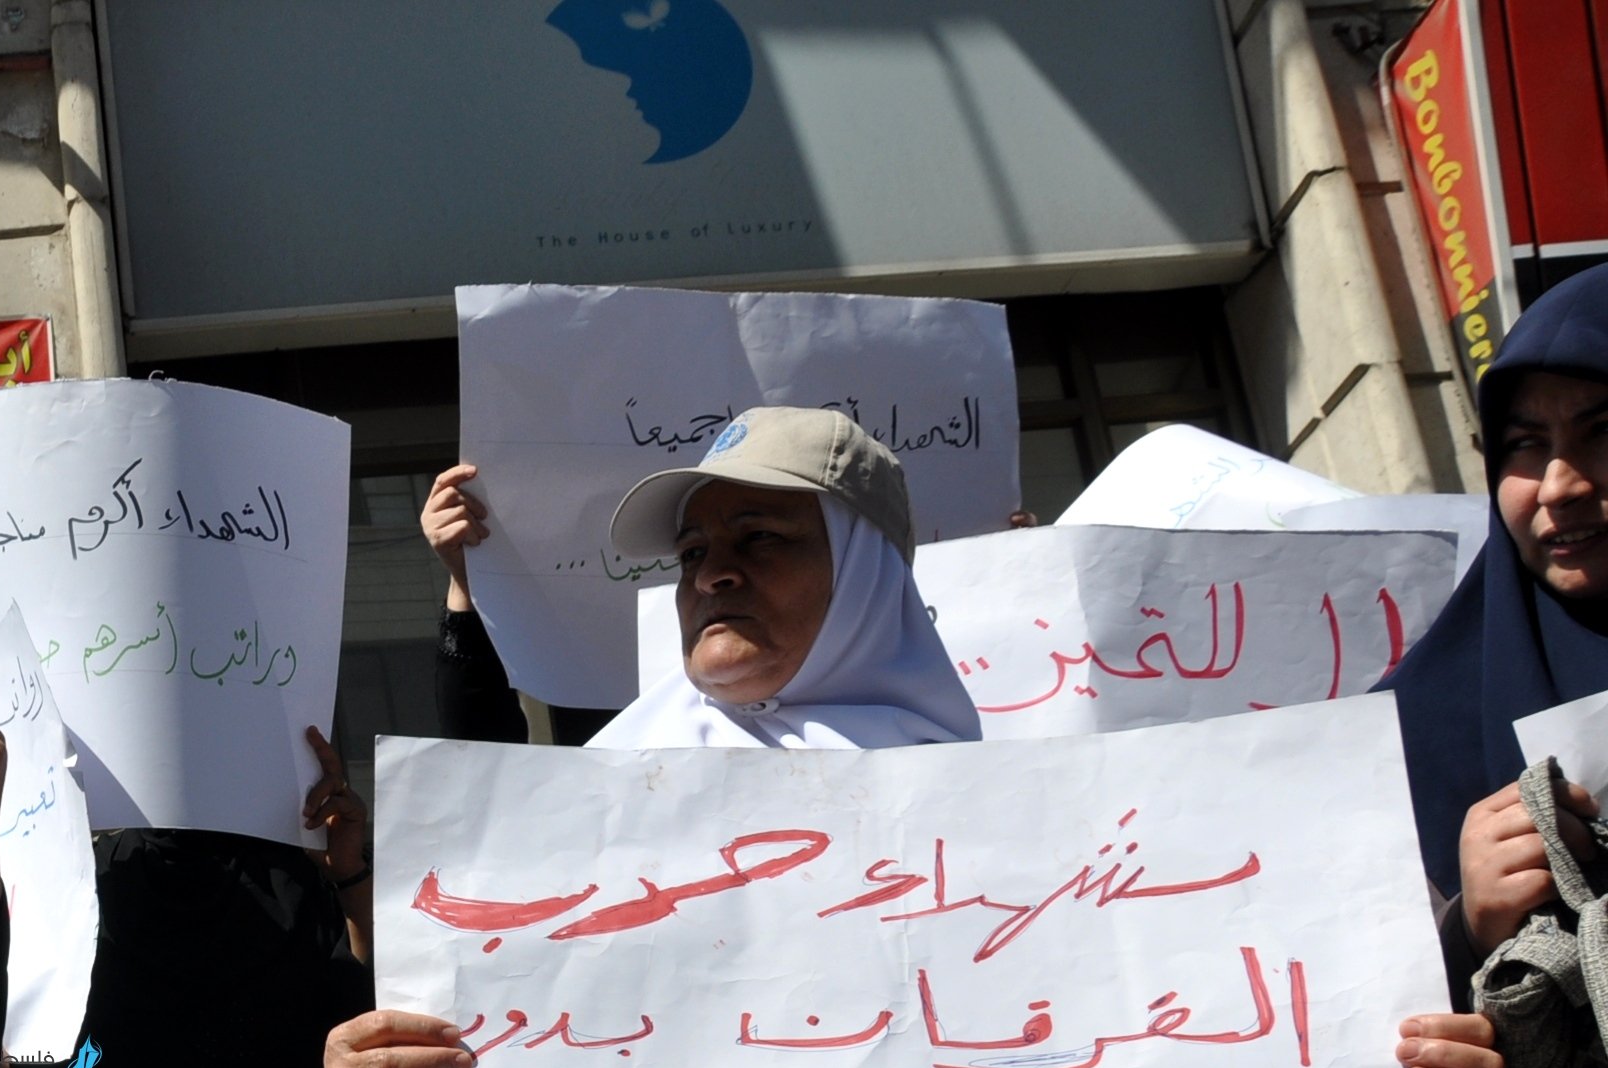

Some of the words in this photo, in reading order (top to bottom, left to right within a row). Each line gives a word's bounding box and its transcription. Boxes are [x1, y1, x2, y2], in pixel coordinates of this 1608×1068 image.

[537, 235, 578, 248] The
[598, 228, 670, 245] House
[690, 222, 709, 238] of
[727, 218, 813, 236] Luxury
[67, 457, 144, 561] أكرم
[158, 486, 290, 551] الشهداء
[82, 601, 178, 684] أسرهم
[191, 619, 297, 687] وراتب
[412, 828, 835, 956] حرب
